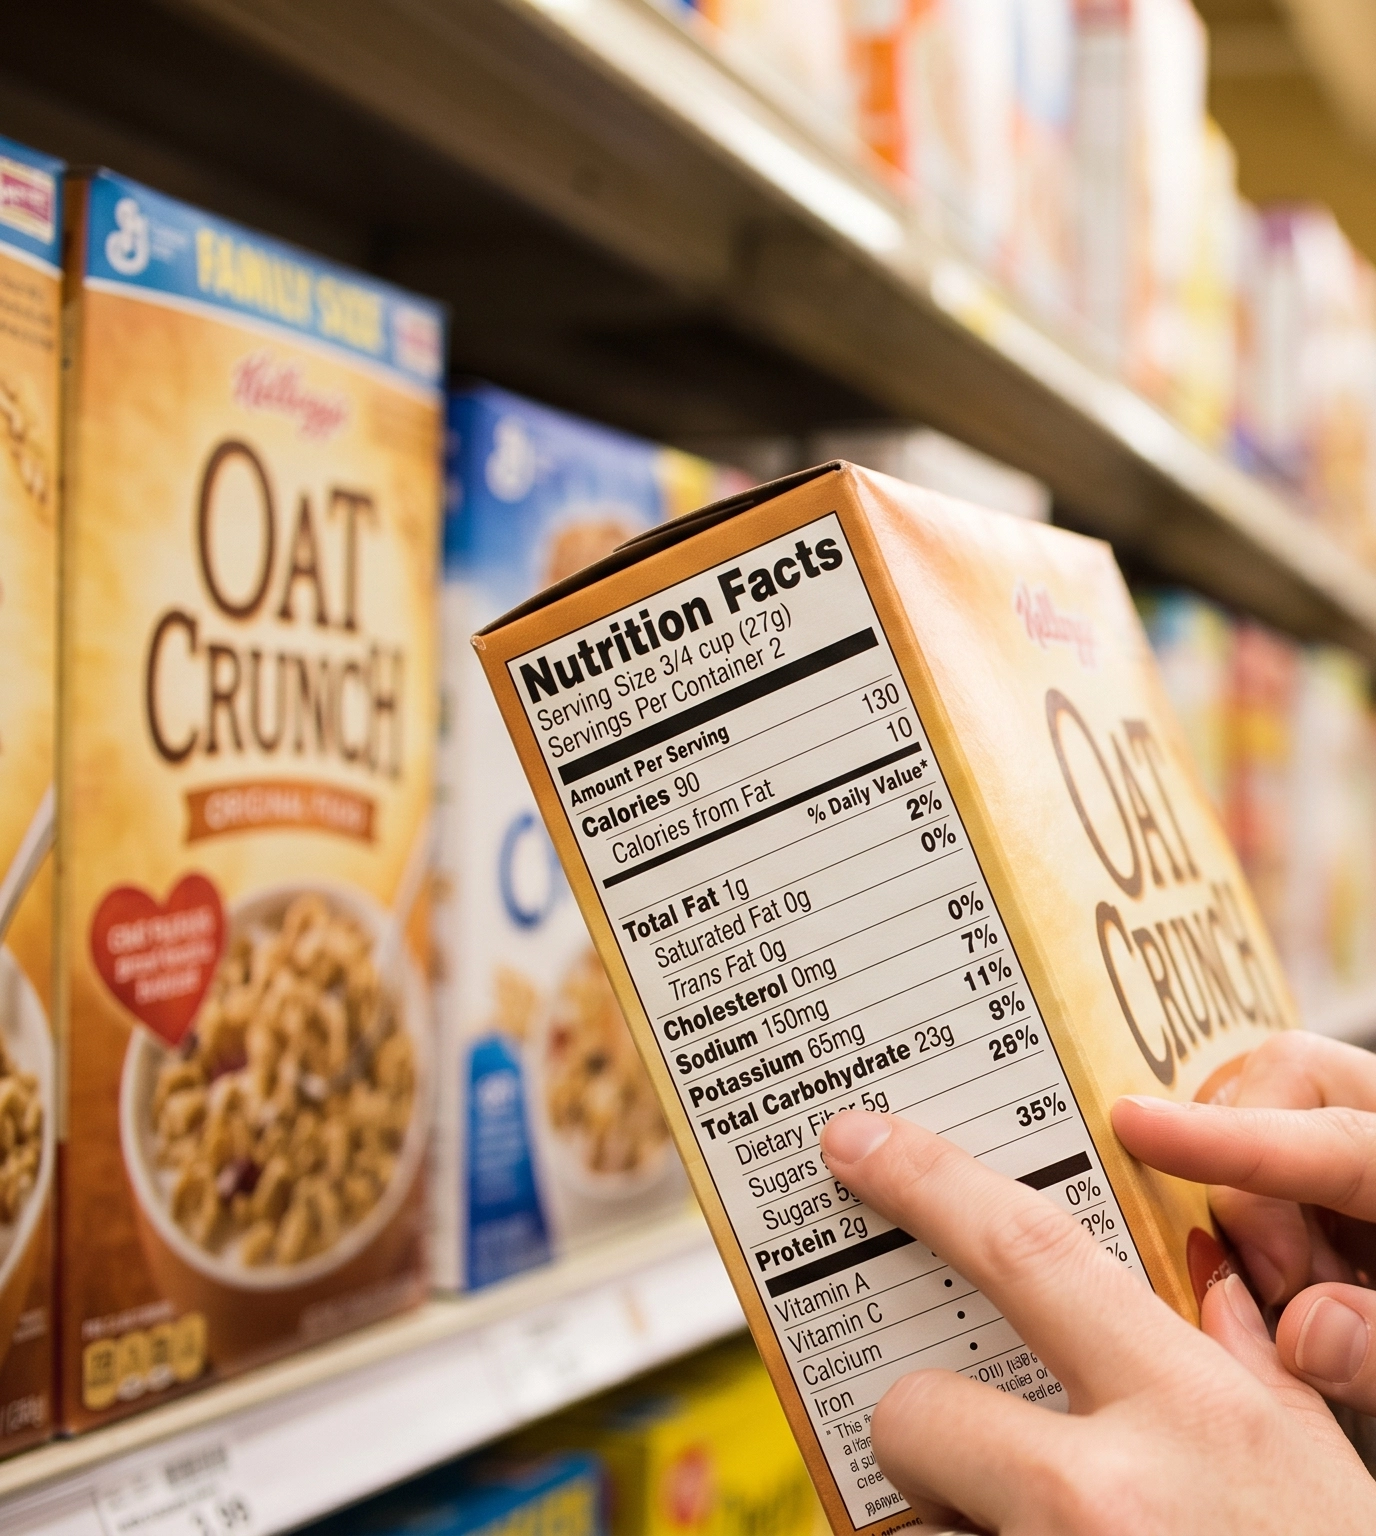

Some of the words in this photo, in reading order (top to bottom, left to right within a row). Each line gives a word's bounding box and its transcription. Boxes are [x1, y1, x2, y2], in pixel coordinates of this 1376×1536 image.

[196, 229, 312, 323] FAMILY
[197, 440, 378, 633] OAT
[517, 595, 714, 705] Nutrition
[715, 537, 843, 615] Facts
[536, 686, 613, 732] Serving
[613, 666, 657, 697] Size
[658, 644, 693, 676] 3/4
[697, 631, 735, 659] cup
[738, 601, 792, 646] (27g)
[147, 608, 405, 781] CRUNCH
[547, 709, 632, 758] Servings
[633, 691, 668, 720] Per
[670, 647, 764, 702] Container
[768, 636, 786, 660] 2
[580, 787, 671, 838] Calories
[672, 770, 700, 798] 90
[860, 681, 900, 714] 130
[569, 765, 634, 808] Amount
[632, 753, 663, 778] Per
[664, 725, 730, 763] Serving
[611, 818, 691, 864] Calories
[691, 796, 740, 829] from
[739, 778, 776, 808] Fat
[885, 715, 913, 742] 10
[806, 802, 827, 824] %
[826, 785, 871, 815] Daily
[1045, 688, 1199, 898] OAT
[620, 902, 679, 943] Total
[680, 886, 721, 919] Fat
[721, 877, 750, 901] 1g
[905, 788, 943, 822] 2%
[653, 912, 747, 969] Saturated
[747, 898, 782, 929] Fat
[782, 889, 812, 914] 0g
[919, 822, 957, 853] 0%
[662, 972, 789, 1042] Cholesterol
[789, 957, 837, 988] 0mg
[946, 889, 984, 921] 0%
[666, 966, 722, 1001] Trans
[724, 947, 758, 978] Fat
[758, 939, 787, 963] 0g
[674, 1029, 759, 1075] Sodium
[760, 998, 830, 1038] 150mg
[959, 922, 998, 954] 7%
[686, 1048, 805, 1109] Potassium
[806, 1023, 866, 1059] 65mg
[962, 955, 1013, 992] 11%
[1095, 879, 1286, 1087] CRUNCH
[699, 1100, 760, 1141] Total
[761, 1042, 911, 1115] Carbohydrate
[913, 1023, 955, 1054] 23g
[733, 1124, 803, 1166] Dietary
[859, 1090, 890, 1114] 5g
[747, 1159, 818, 1198] Sugars
[761, 1191, 833, 1230] Sugars
[1015, 1091, 1067, 1127] 35%
[753, 1227, 837, 1273] Protein
[838, 1215, 869, 1239] 2g
[772, 1281, 851, 1322] Vitamin
[854, 1271, 871, 1295] A
[1064, 1175, 1102, 1206] 0%
[786, 1312, 864, 1354] Vitamin
[865, 1301, 883, 1324] C
[801, 1343, 883, 1386] Calcium
[813, 1390, 855, 1418] Iron
[832, 1420, 863, 1439] This
